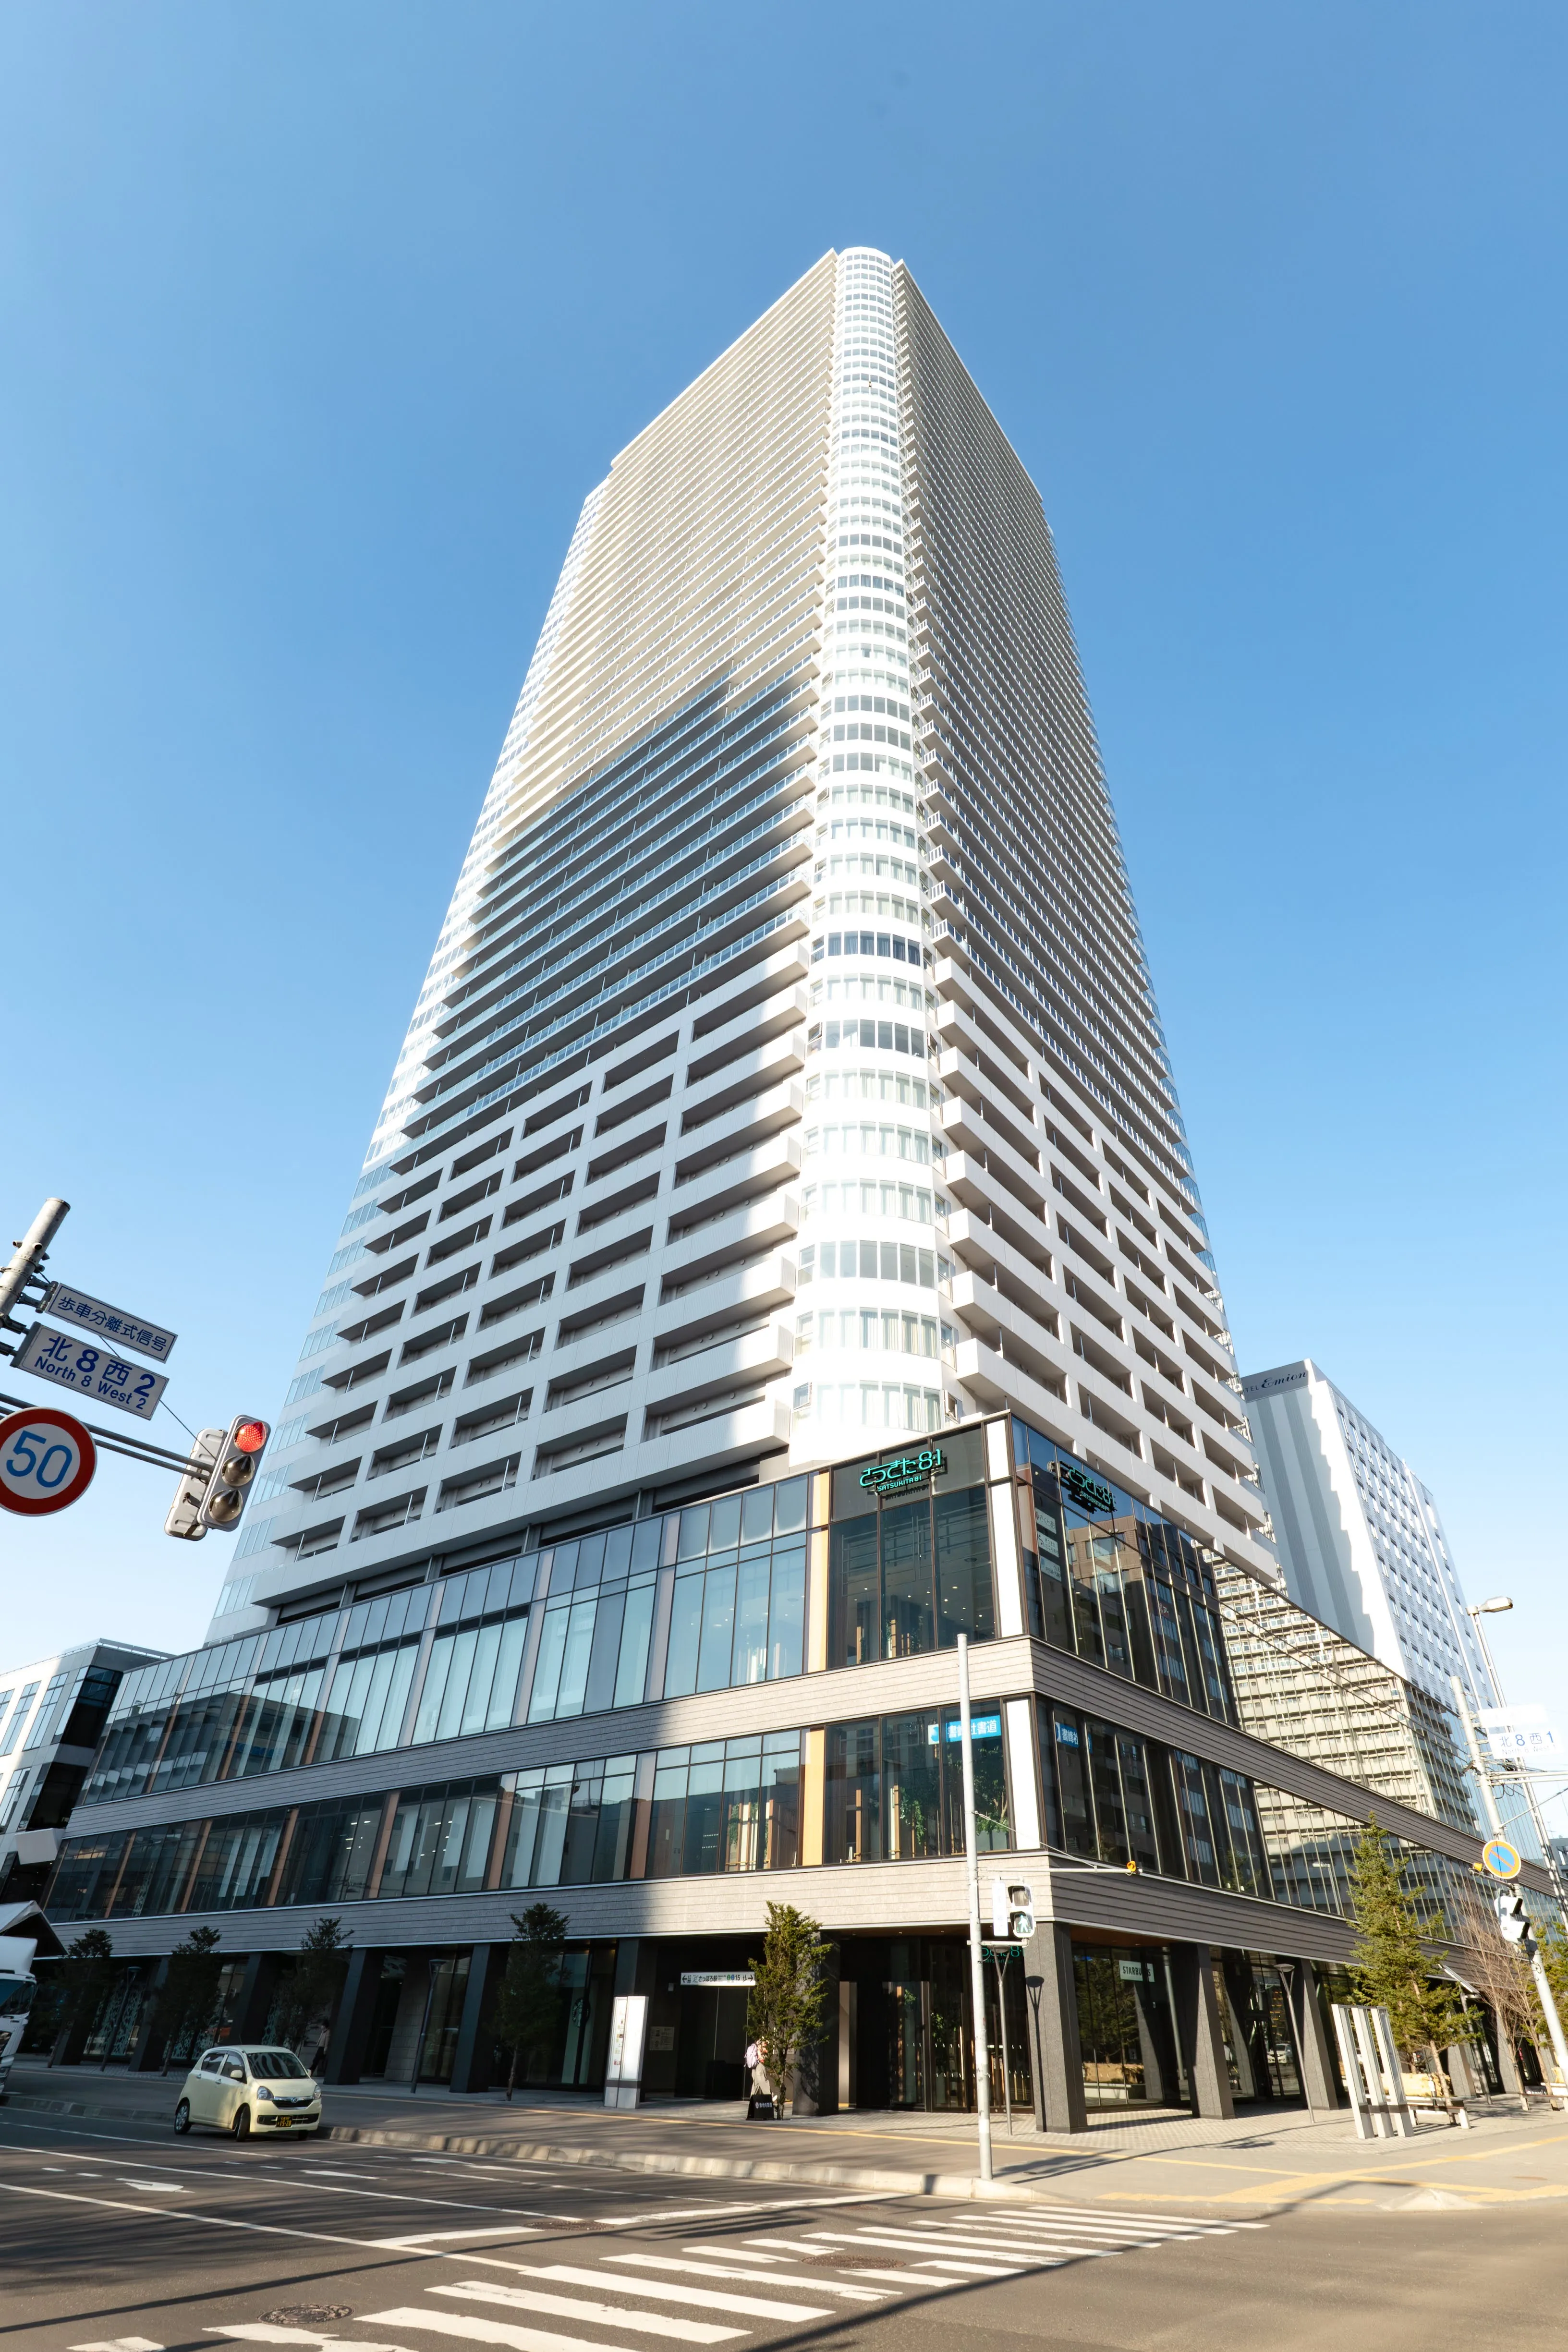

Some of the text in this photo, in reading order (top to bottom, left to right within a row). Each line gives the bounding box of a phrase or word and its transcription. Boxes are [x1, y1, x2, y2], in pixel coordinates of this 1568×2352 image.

[57, 1296, 167, 1352] 歩車分離式信号
[34, 1356, 146, 1410] North 8 West 2
[1244, 1371, 1306, 1393] TEL Emion
[6, 1430, 73, 1488] 50
[877, 1478, 913, 1492] SATSUKITA
[1122, 1965, 1151, 1976] STARBUS
